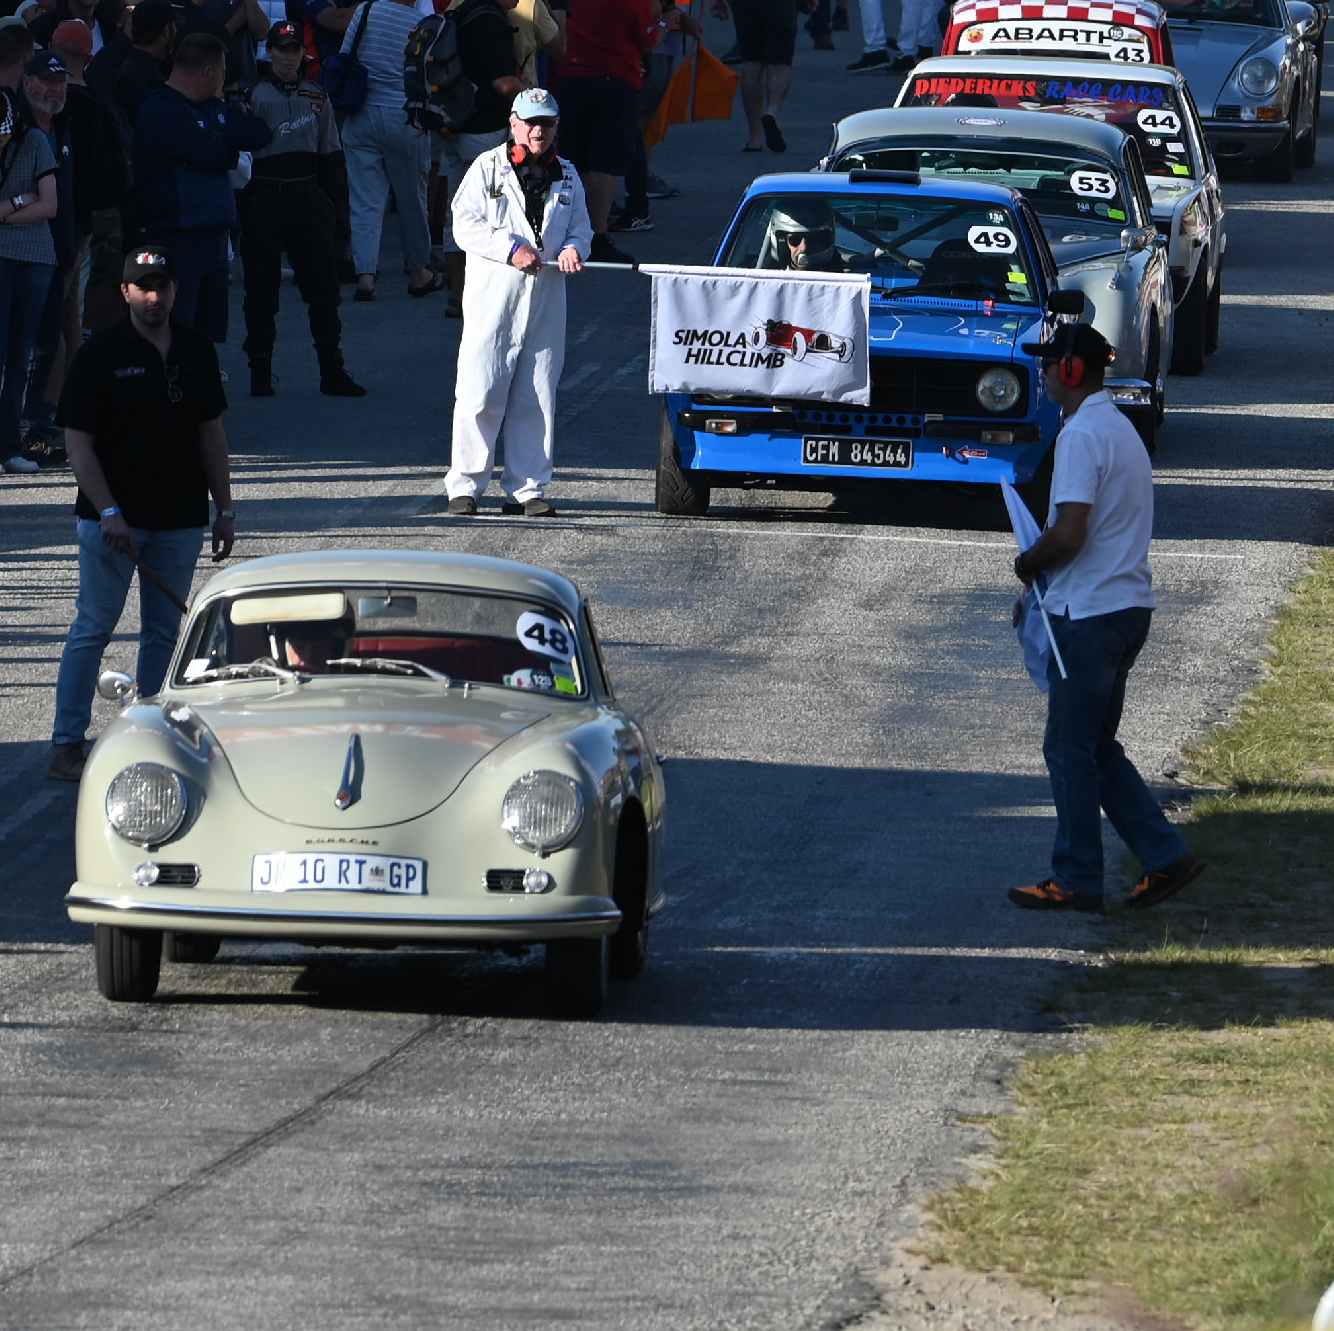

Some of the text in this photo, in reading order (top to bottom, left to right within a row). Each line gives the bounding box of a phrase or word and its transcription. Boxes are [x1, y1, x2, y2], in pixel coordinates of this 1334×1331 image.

[989, 26, 1115, 45] ABARTH
[1114, 47, 1145, 62] 43
[914, 77, 1164, 106] DIEDERICKS RACE CARS
[1141, 114, 1178, 130] 44
[1078, 176, 1112, 194] 53
[973, 231, 1012, 249] 49
[672, 328, 747, 349] SIMOLA
[684, 347, 786, 369] HILLCLIMB
[805, 439, 907, 467] CFM 84544
[524, 623, 569, 654] 48
[298, 858, 326, 884] 10
[338, 858, 368, 885] RT
[389, 862, 417, 890] GP
